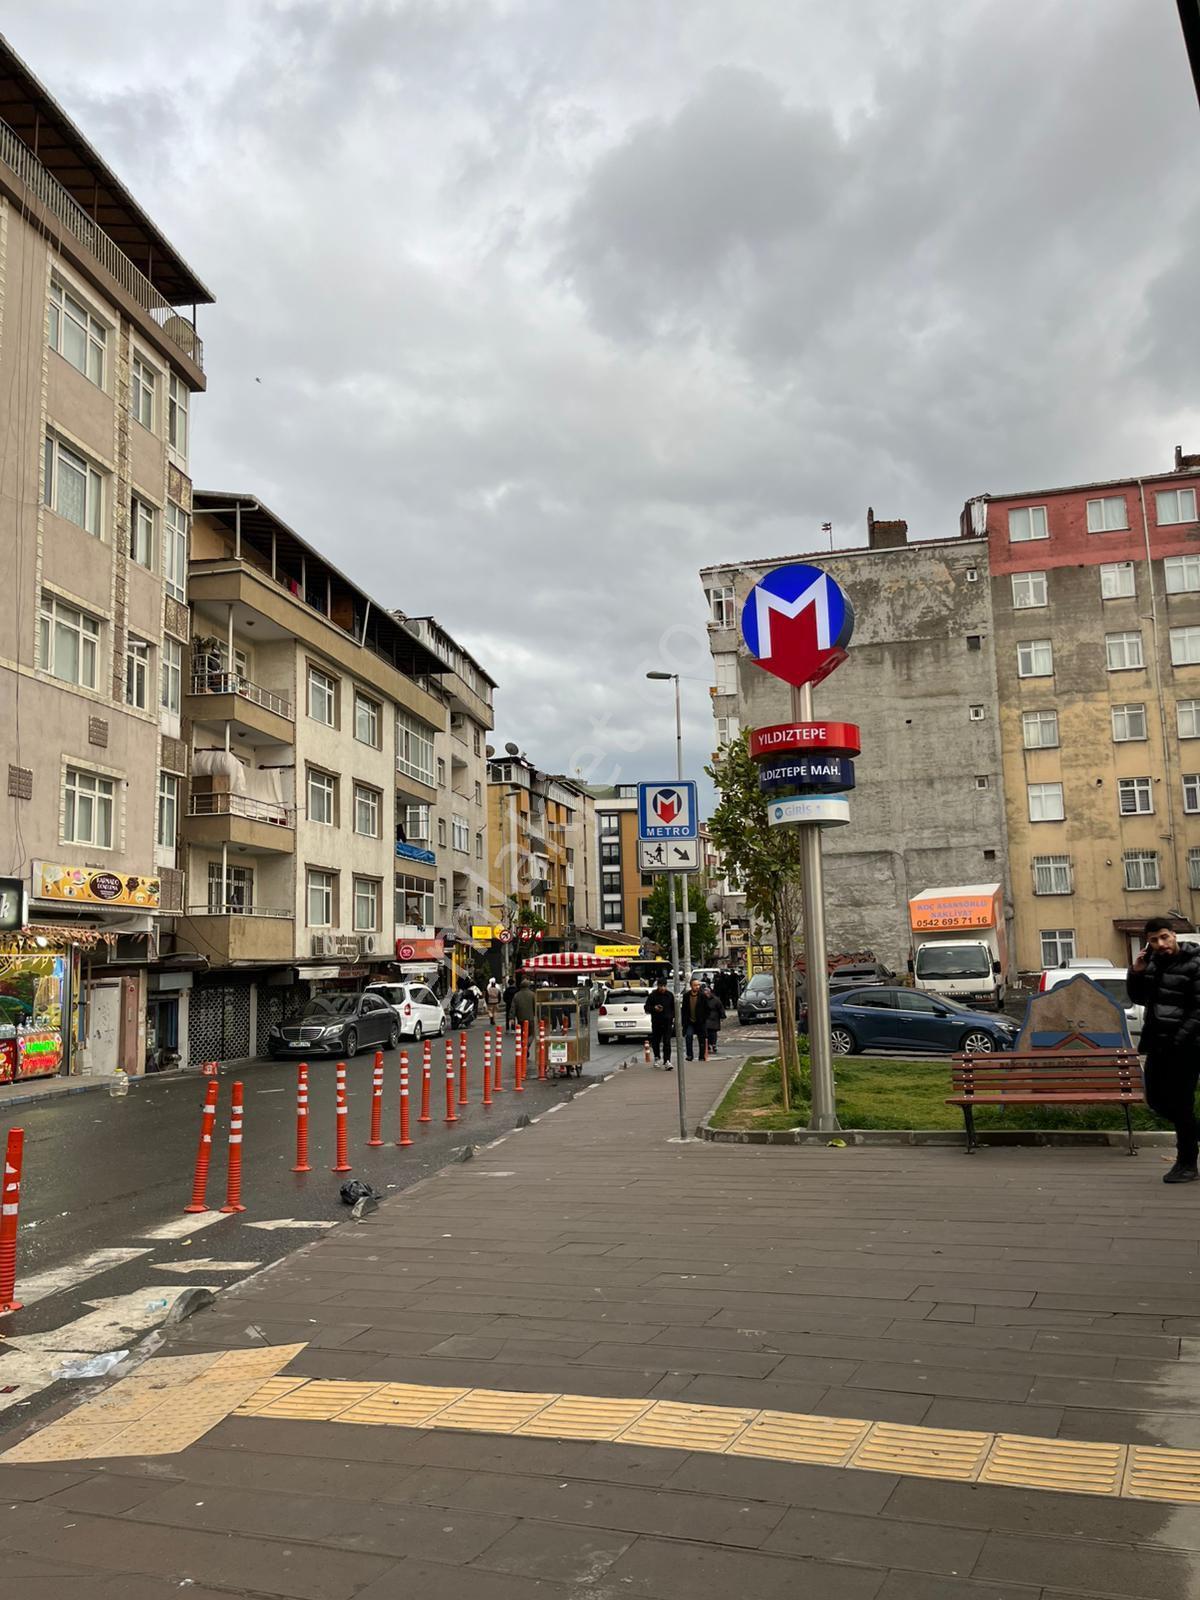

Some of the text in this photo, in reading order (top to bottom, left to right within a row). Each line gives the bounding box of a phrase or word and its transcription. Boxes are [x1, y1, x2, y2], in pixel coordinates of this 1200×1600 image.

[758, 727, 826, 746] YILDIZTEPE
[760, 765, 841, 780] ILDIZTEPE MAH.
[646, 827, 690, 836] METRO
[917, 919, 939, 927] 0542
[941, 918, 959, 926] 695
[977, 916, 988, 924] 16
